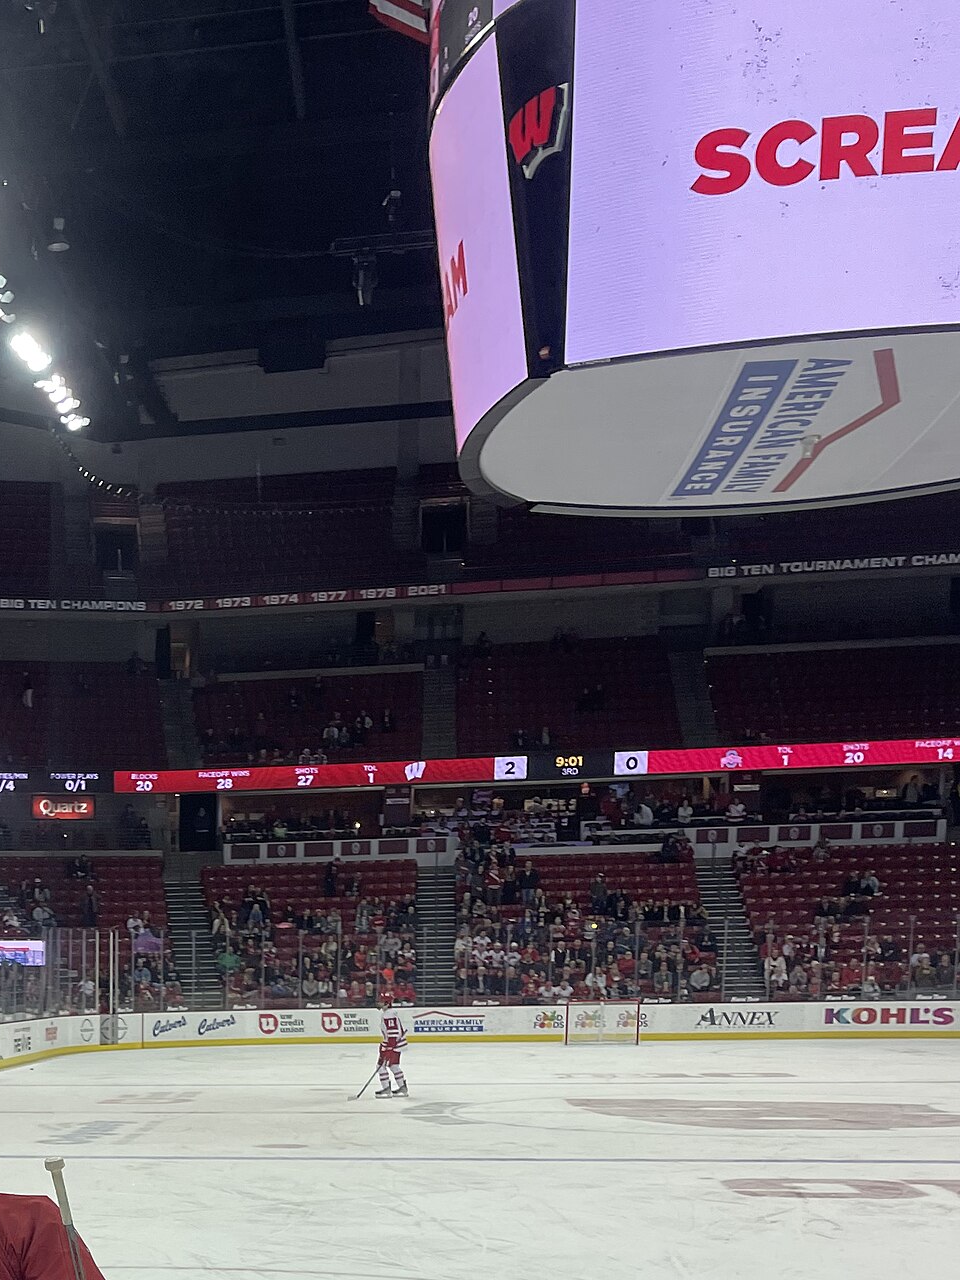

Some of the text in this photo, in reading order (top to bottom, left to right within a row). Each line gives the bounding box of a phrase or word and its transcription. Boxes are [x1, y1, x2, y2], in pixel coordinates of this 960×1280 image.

[753, 359, 853, 449] AMERICAN
[685, 375, 779, 490] INSURANCE
[708, 566, 736, 577] BIG
[741, 564, 774, 576] TEN
[779, 556, 906, 573] TOURNAMENT
[0, 584, 446, 611] BIG TEN CHAMPIONS 1972 1973 1974 1977 1978 2021
[843, 743, 869, 751] SHOTS
[915, 740, 952, 748] FACEOFF
[844, 752, 864, 764] 20
[937, 748, 954, 760] 14
[555, 755, 583, 767] 9:01
[626, 756, 638, 770] 0
[782, 755, 788, 766] 1
[295, 767, 319, 775] SHOTS
[363, 764, 377, 772] TOL
[504, 761, 516, 775] 2
[562, 767, 579, 776] 3RD
[198, 770, 230, 779] FACEOFF
[297, 775, 314, 786] 27
[368, 772, 374, 784] 1
[65, 780, 86, 792] 0/1
[135, 781, 153, 792] 20
[216, 778, 233, 789] 28
[39, 799, 88, 816] Quartz
[695, 1008, 780, 1026] ANNEX
[824, 1007, 955, 1026] KOHL'S
